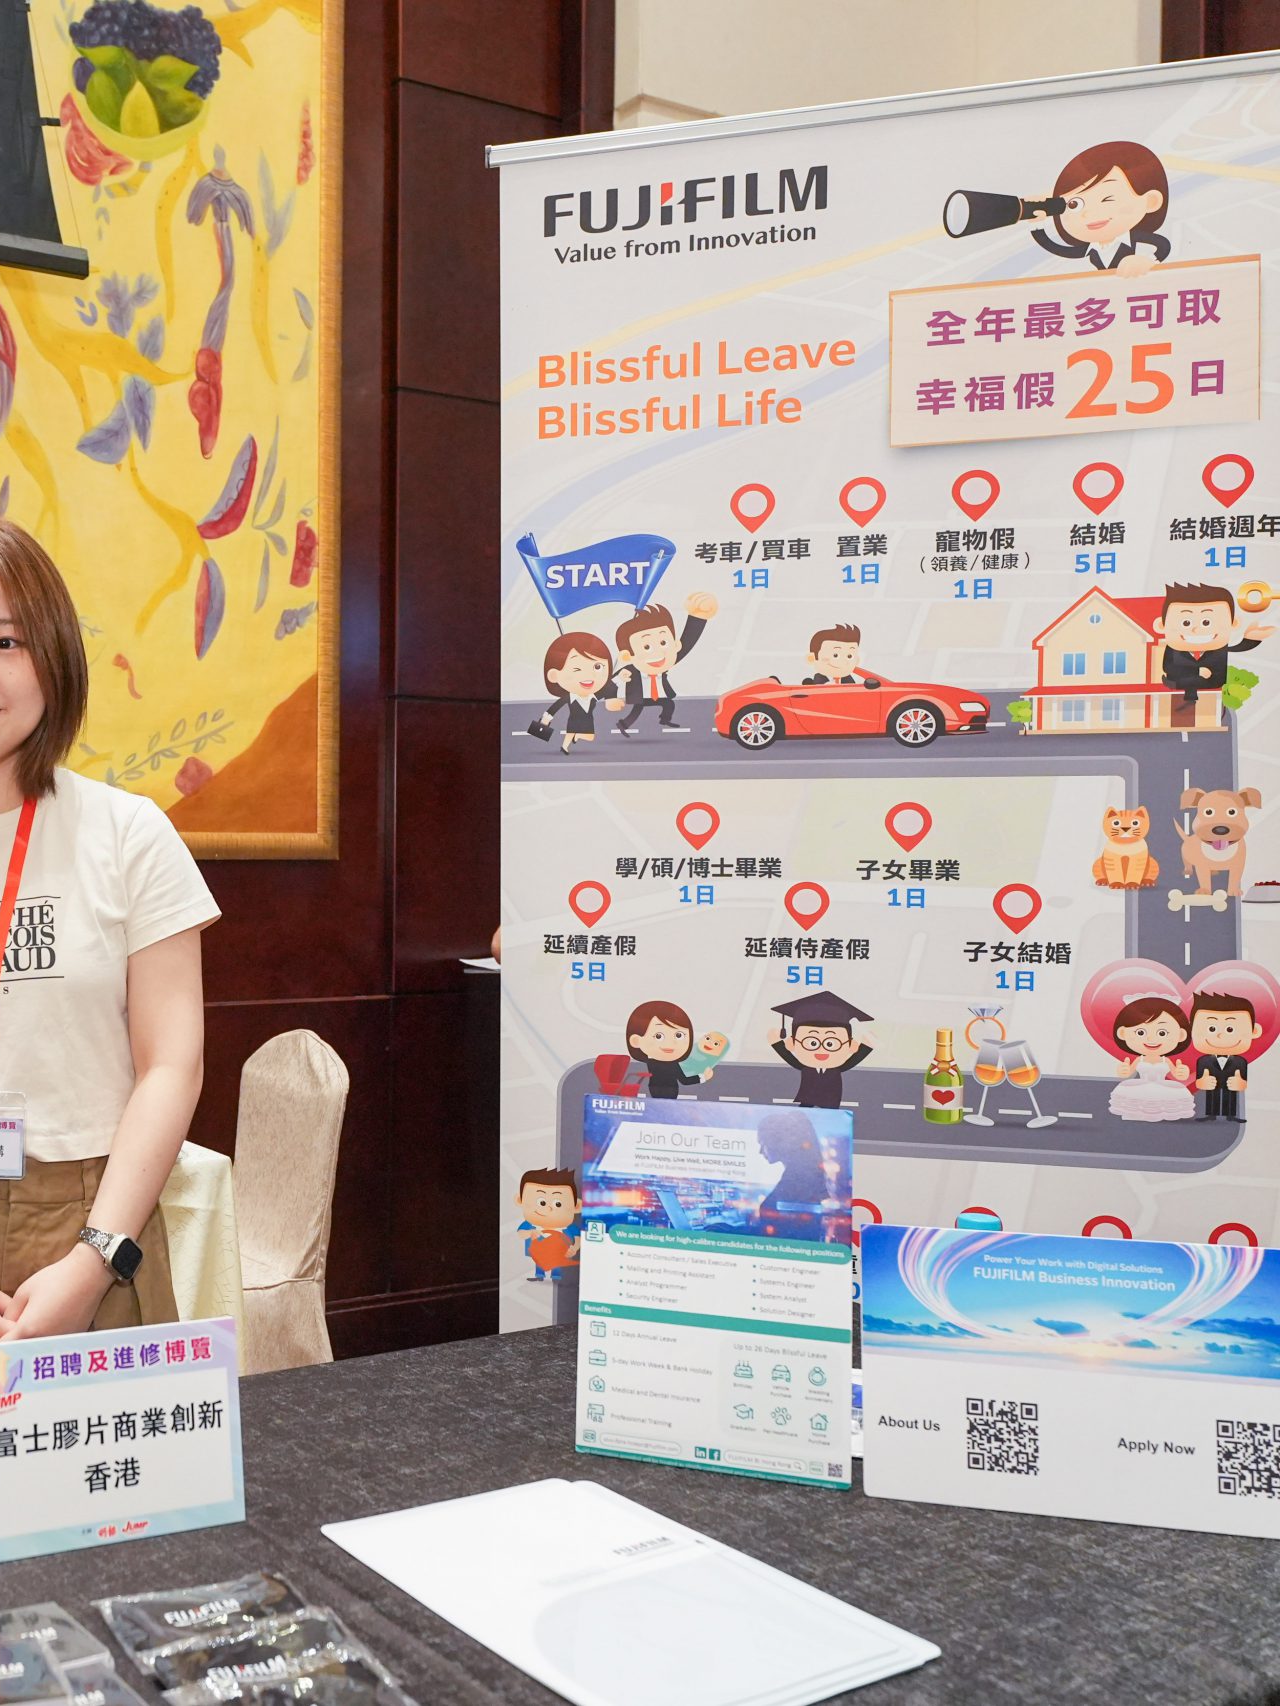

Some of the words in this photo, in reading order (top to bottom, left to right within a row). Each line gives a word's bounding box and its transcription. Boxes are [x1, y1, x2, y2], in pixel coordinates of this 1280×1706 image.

[543, 165, 828, 238] FUJIFILM
[554, 243, 617, 264] Value
[624, 239, 681, 258] from
[689, 224, 817, 252] Innovation
[925, 288, 1221, 347] 全年最多可取
[538, 342, 701, 389] Blissful
[718, 338, 856, 375] Leave
[538, 394, 700, 440] Blissful
[717, 388, 802, 428] Life
[1069, 521, 1126, 546] 結婚
[1169, 514, 1280, 542] 結婚週年
[694, 537, 812, 565] 考車/買車
[836, 533, 889, 558] 置業
[935, 527, 1016, 553] 寵物假
[1074, 551, 1117, 574] 5日
[1204, 546, 1247, 569] 1日
[545, 561, 650, 590] START
[732, 568, 770, 590] 1日
[842, 563, 880, 585] 1日
[953, 578, 993, 600] 1日
[615, 857, 782, 880] 學/碩/博士畢業
[856, 859, 961, 882] 子女畢業
[678, 885, 714, 905] 1日
[887, 888, 926, 909] 1日
[543, 934, 637, 956] 延續產假
[744, 937, 870, 960] 延續侍產假
[963, 941, 1072, 965] 子女結婚
[570, 962, 606, 982] 5日
[786, 965, 824, 986] 5日
[995, 970, 1035, 991] 1日
[636, 1131, 666, 1145] Join
[671, 1132, 699, 1147] Our
[704, 1134, 747, 1151] Team
[984, 1254, 1013, 1265] Power
[1015, 1256, 1036, 1266] Your
[1038, 1258, 1063, 1268] Work
[1065, 1259, 1086, 1270] with
[1087, 1261, 1118, 1273] Digital
[1119, 1263, 1164, 1275] Solutions
[973, 1266, 1036, 1282] FUJIFILM
[1038, 1271, 1099, 1287] Business
[1102, 1276, 1176, 1292] Innovation
[33, 1336, 213, 1381] 招聘及進修博覽
[878, 1415, 919, 1431] About
[923, 1419, 941, 1432] Us
[1117, 1437, 1159, 1456] Apply
[1163, 1440, 1196, 1456] Now
[84, 1456, 141, 1494] 香港
